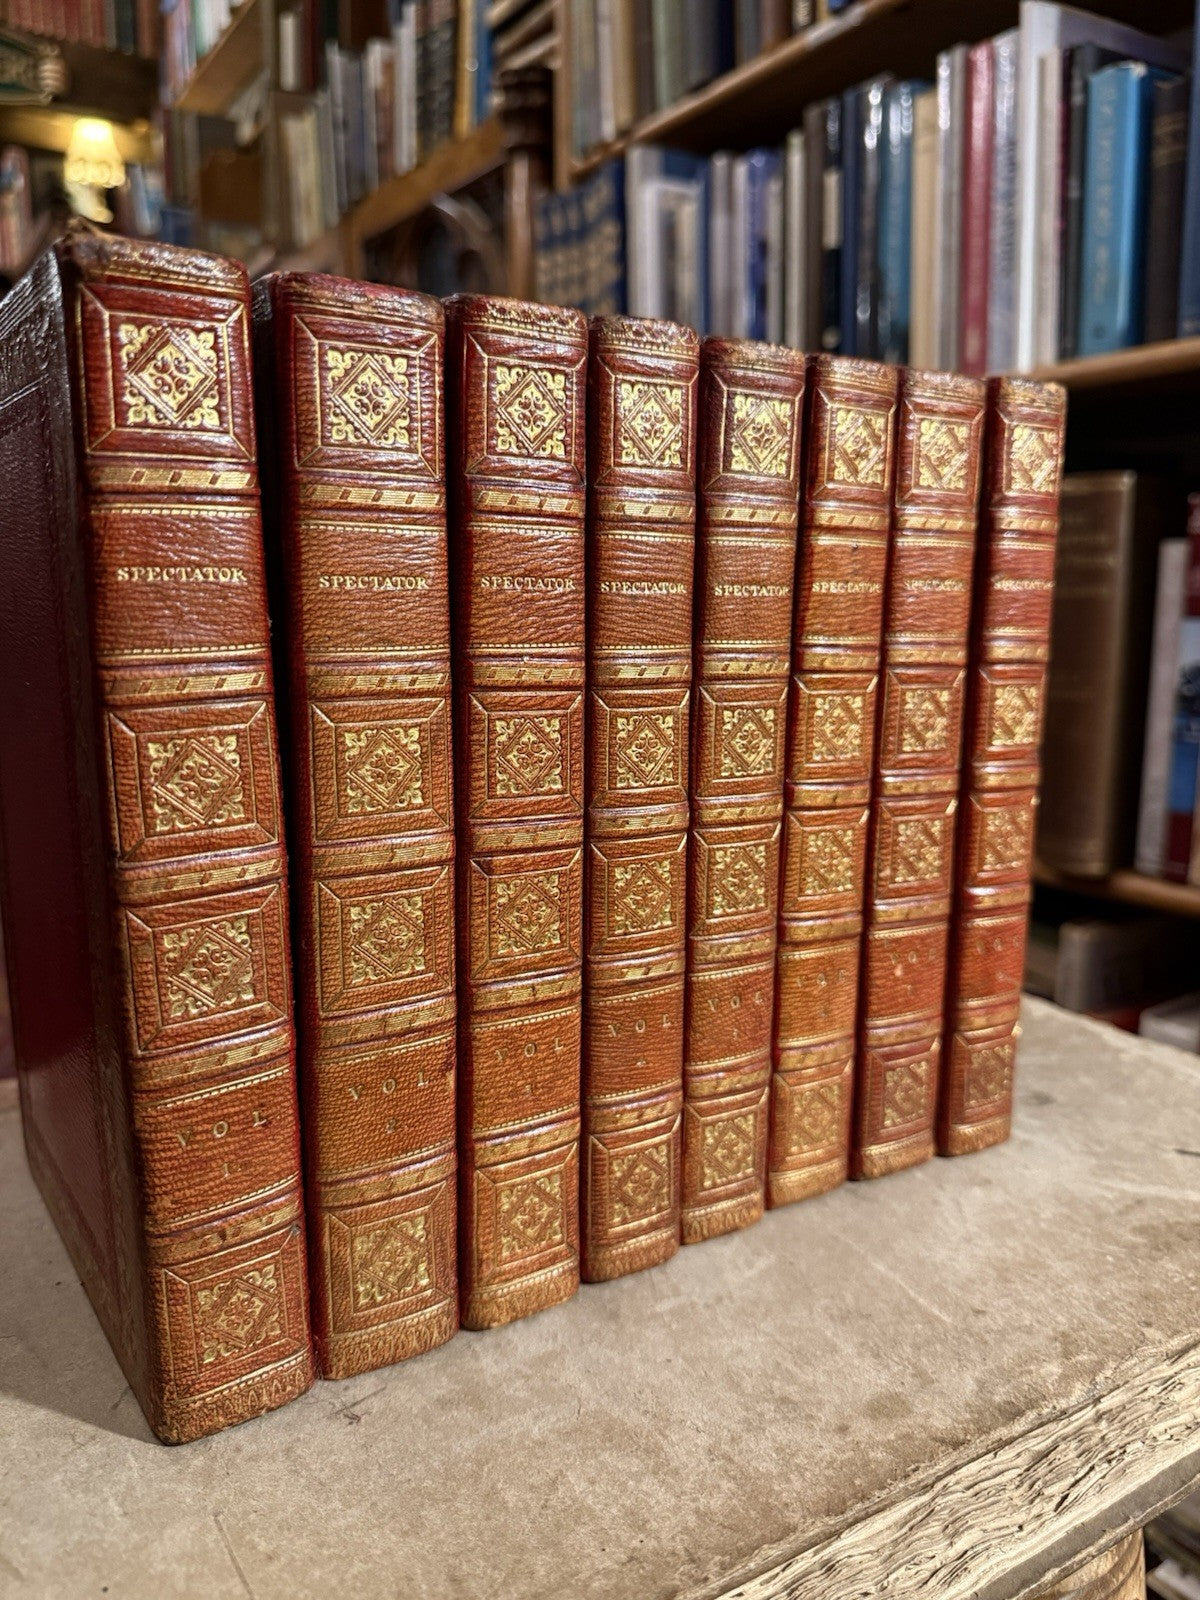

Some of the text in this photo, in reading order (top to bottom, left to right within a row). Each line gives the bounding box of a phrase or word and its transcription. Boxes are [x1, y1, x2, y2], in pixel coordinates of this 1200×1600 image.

[117, 566, 247, 583] SPECTATOR
[319, 575, 430, 590] SPECTATOR
[480, 576, 576, 591] SPECTATOR
[600, 580, 687, 595] SPECTATOR
[713, 584, 789, 598] SPECTATOR
[607, 1013, 672, 1037] VOL
[495, 1037, 564, 1062] VOL
[348, 1070, 430, 1100] VOL
[175, 1110, 268, 1147] VOL
